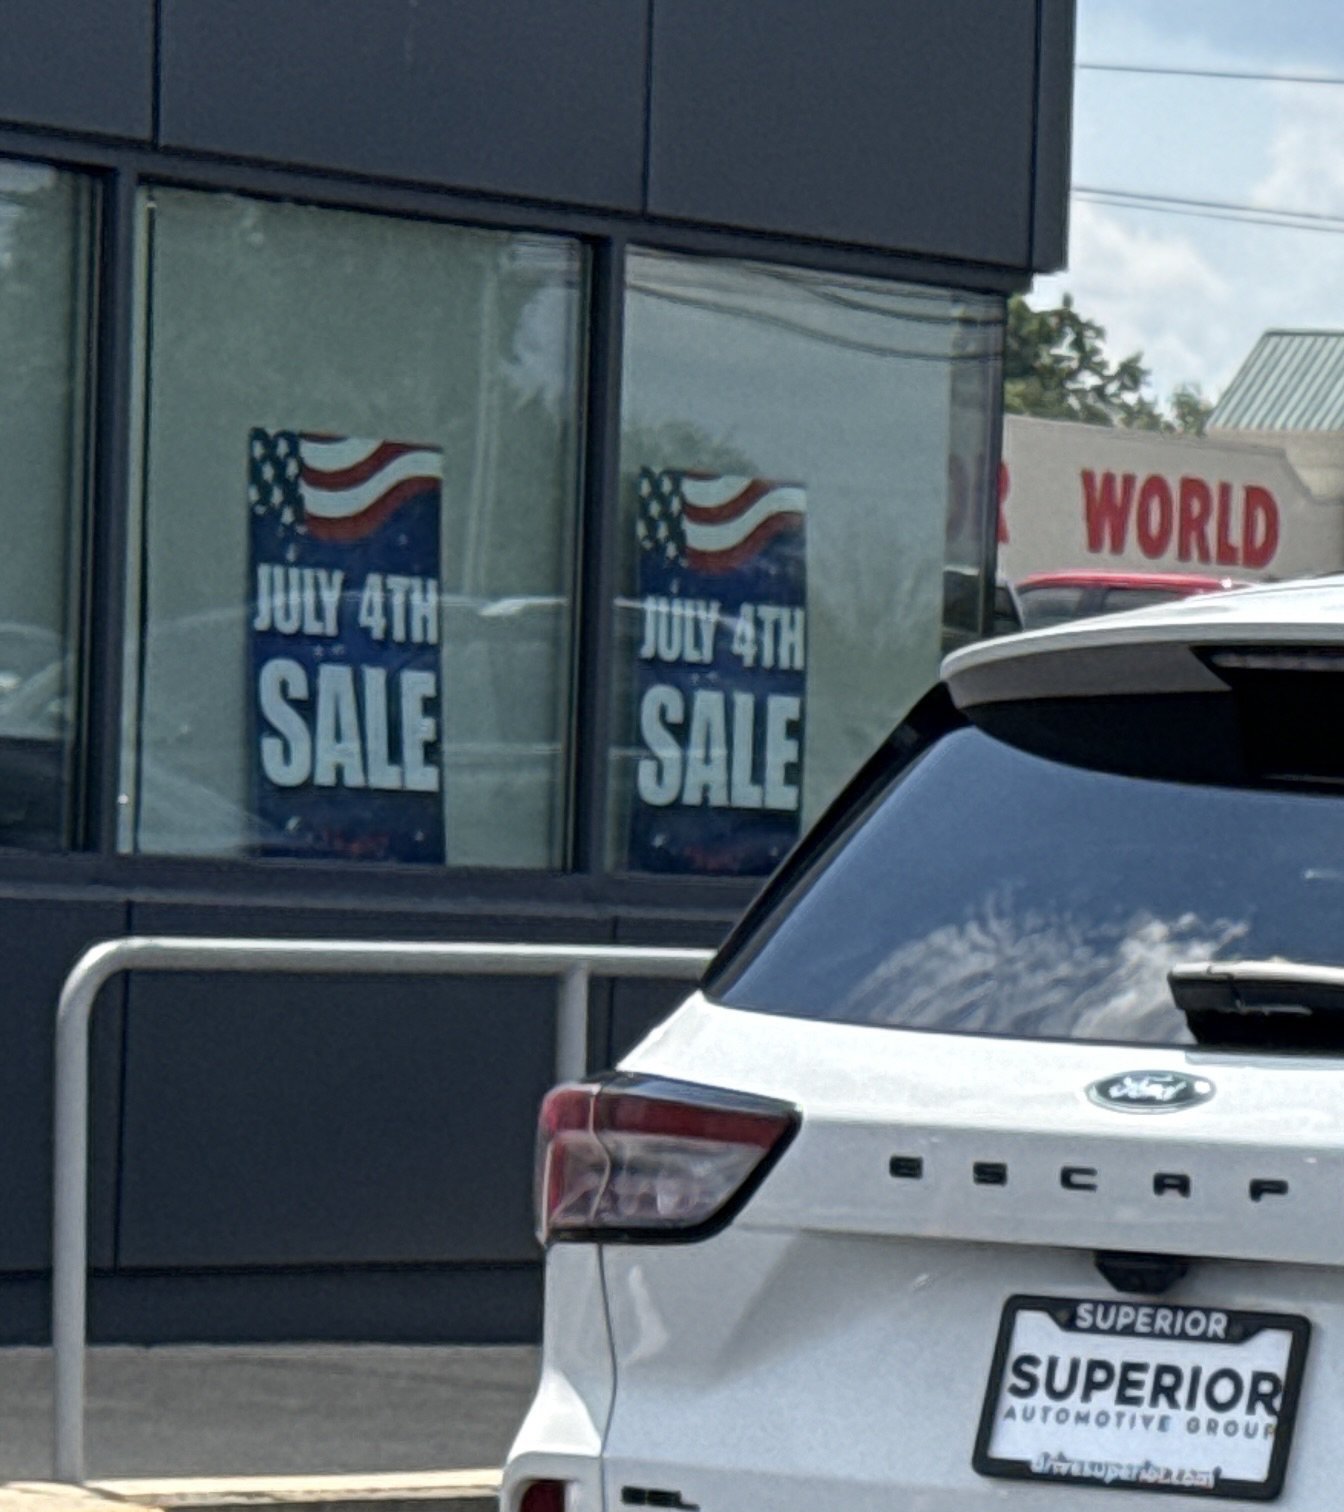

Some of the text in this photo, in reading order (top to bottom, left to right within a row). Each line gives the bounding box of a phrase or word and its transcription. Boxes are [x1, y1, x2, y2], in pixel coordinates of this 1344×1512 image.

[1080, 467, 1280, 569] WORLD
[253, 563, 439, 645] JULY 4TH
[640, 596, 805, 671] JULY 4TH
[259, 657, 440, 792] SALE
[637, 684, 801, 811] SALE
[1074, 1302, 1229, 1339] SUPERIOR
[1003, 1404, 1277, 1441] AUTOMOTIVE GROUP
[1006, 1353, 1283, 1416] SUPERIOR
